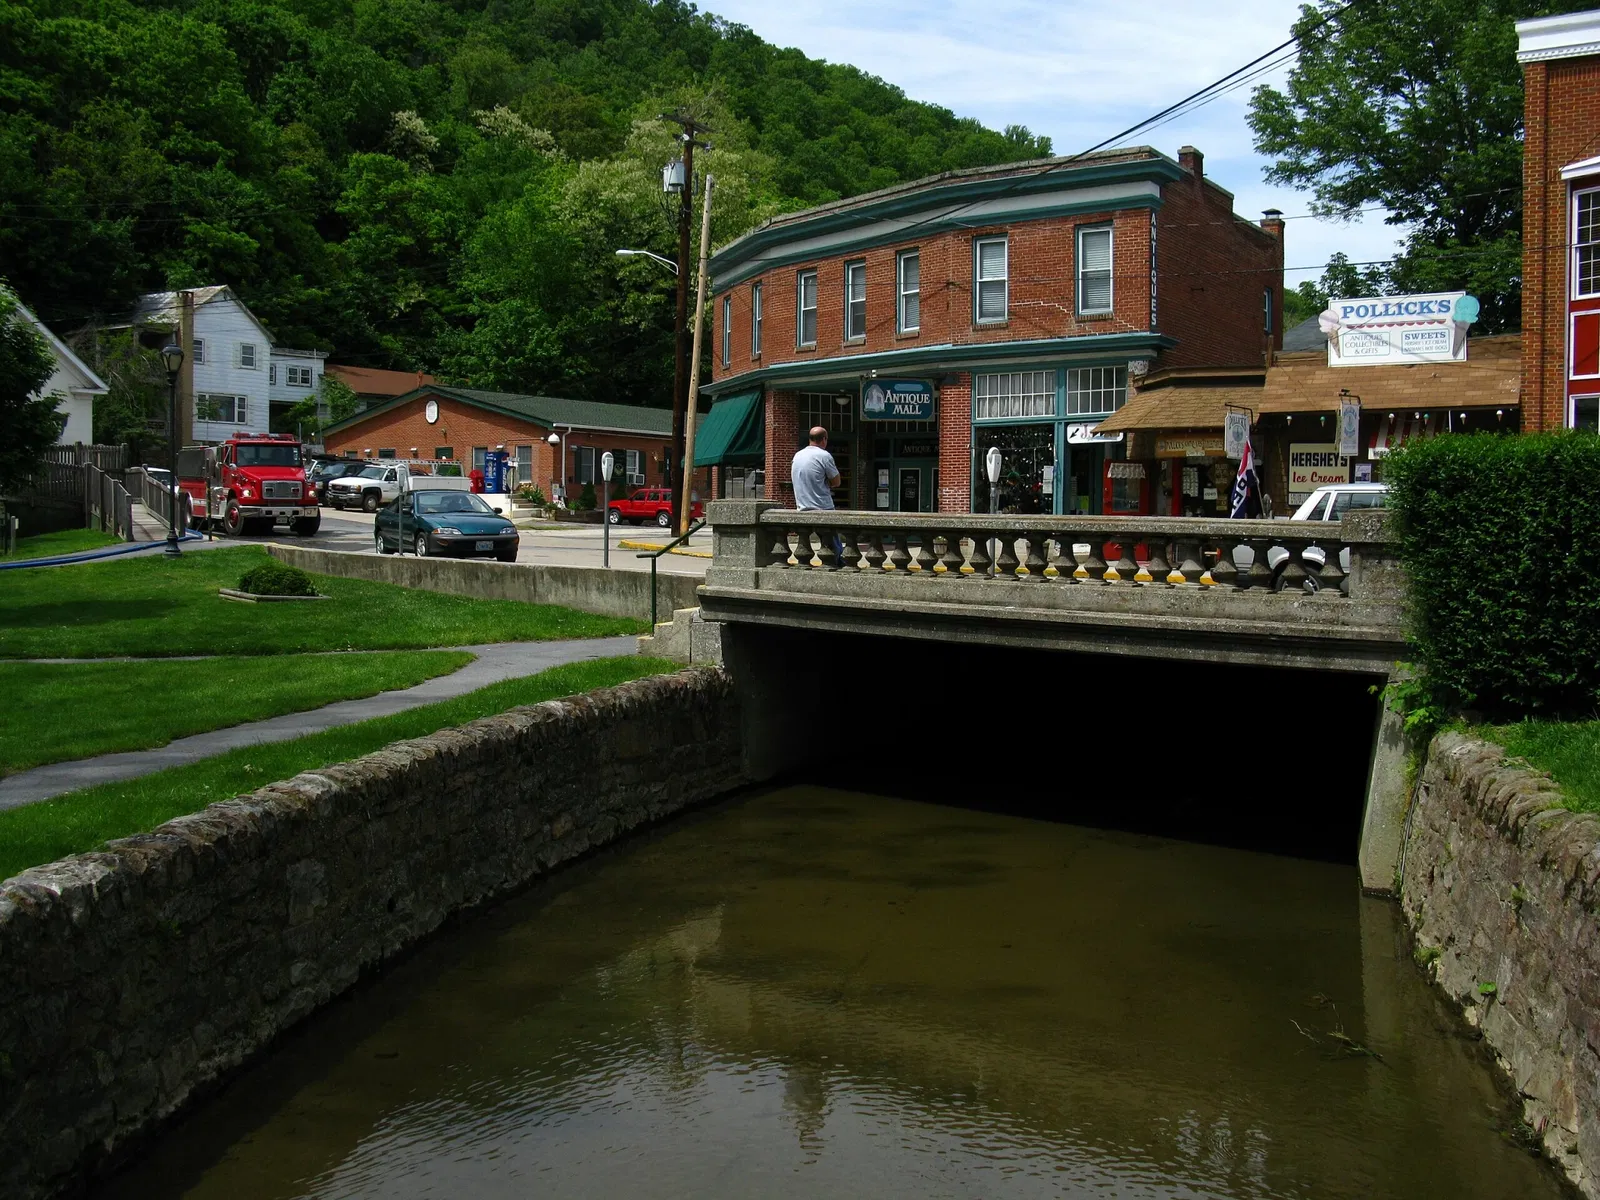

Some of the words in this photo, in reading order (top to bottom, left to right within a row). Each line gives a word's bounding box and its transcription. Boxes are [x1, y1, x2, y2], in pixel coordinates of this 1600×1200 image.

[1341, 299, 1451, 319] POLLICK'S
[1350, 333, 1383, 342] ANTIQUES
[1404, 331, 1446, 341] SWEETS
[1345, 340, 1389, 349] COLLECTIBLES
[884, 389, 931, 405] ANTIQUE
[892, 404, 922, 415] MALL
[1291, 452, 1348, 467] HERSHEYS
[1292, 471, 1307, 483] Ice
[1310, 471, 1346, 483] Cream
